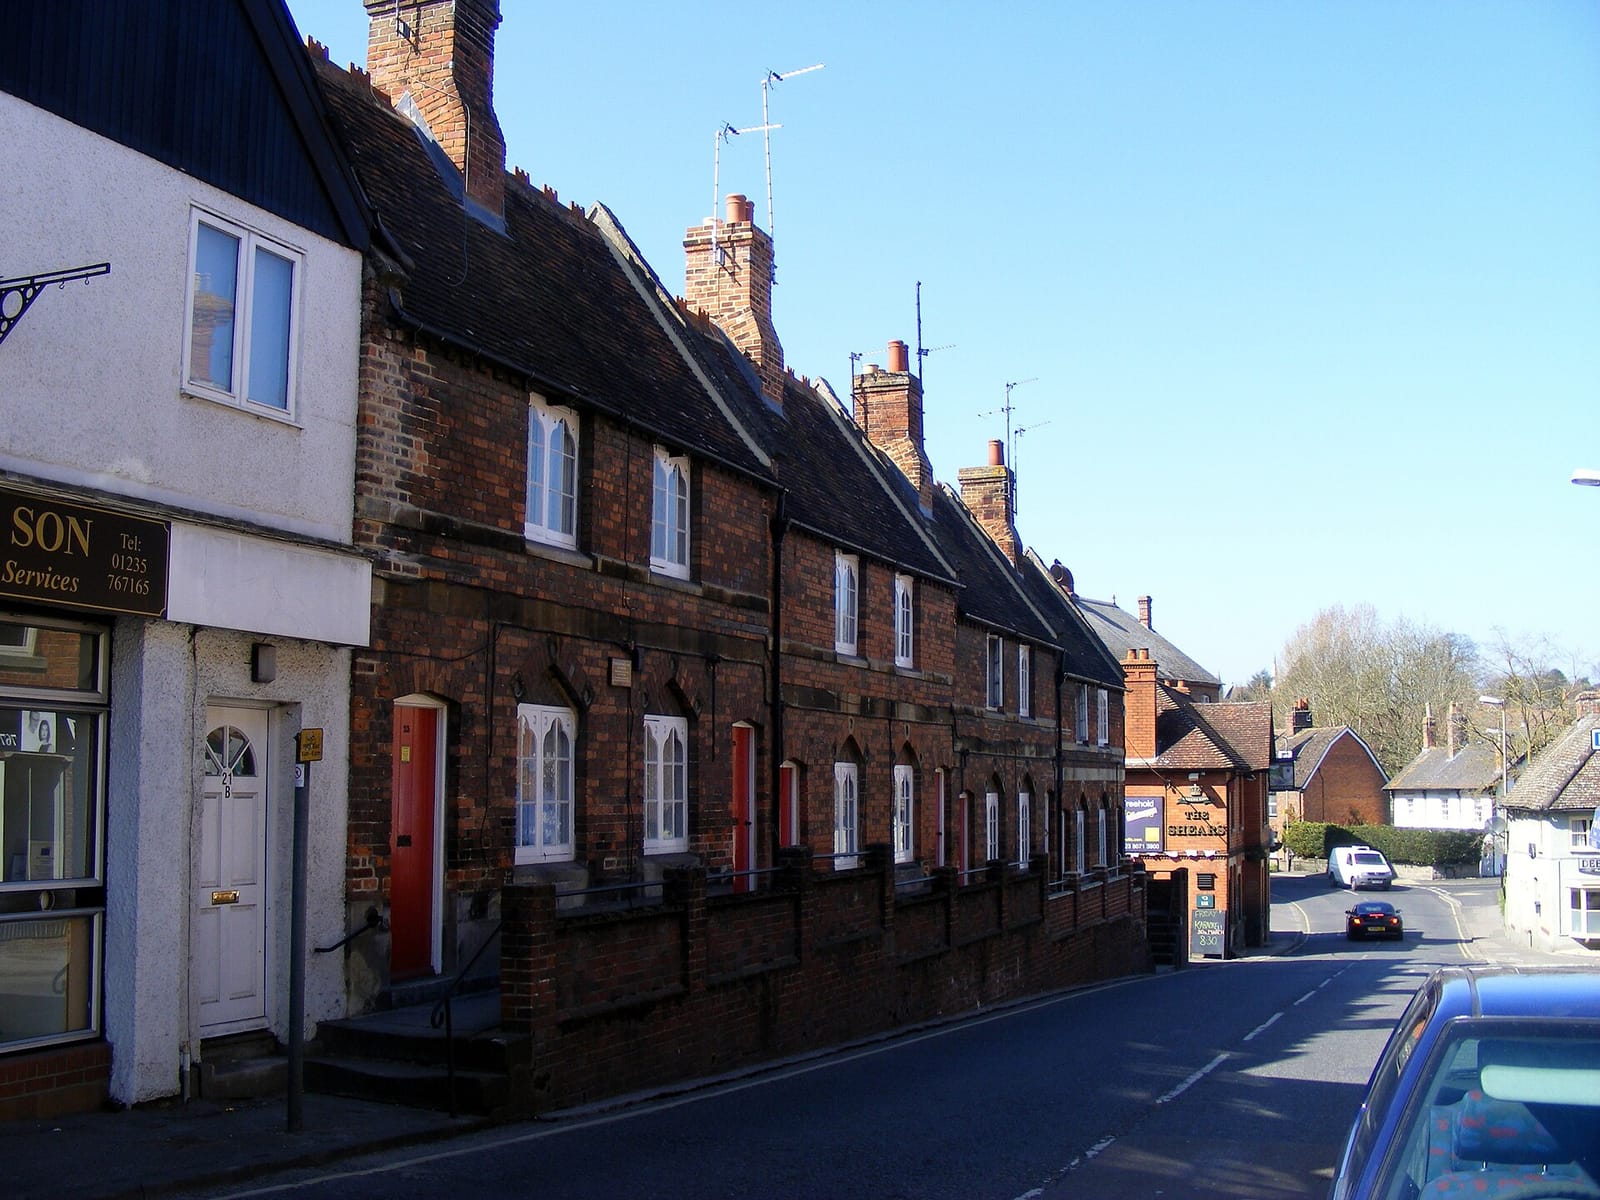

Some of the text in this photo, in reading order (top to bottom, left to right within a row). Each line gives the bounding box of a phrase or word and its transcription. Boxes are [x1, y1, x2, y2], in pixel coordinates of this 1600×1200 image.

[11, 506, 94, 558] SON
[120, 532, 142, 552] Tel:
[111, 553, 147, 574] 01235
[1, 559, 80, 593] Services
[107, 574, 150, 596] 767165
[222, 772, 232, 785] 21
[225, 785, 231, 799] B
[1124, 799, 1155, 808] reehold
[1184, 811, 1210, 821] THE
[1168, 825, 1226, 837] SHEARS
